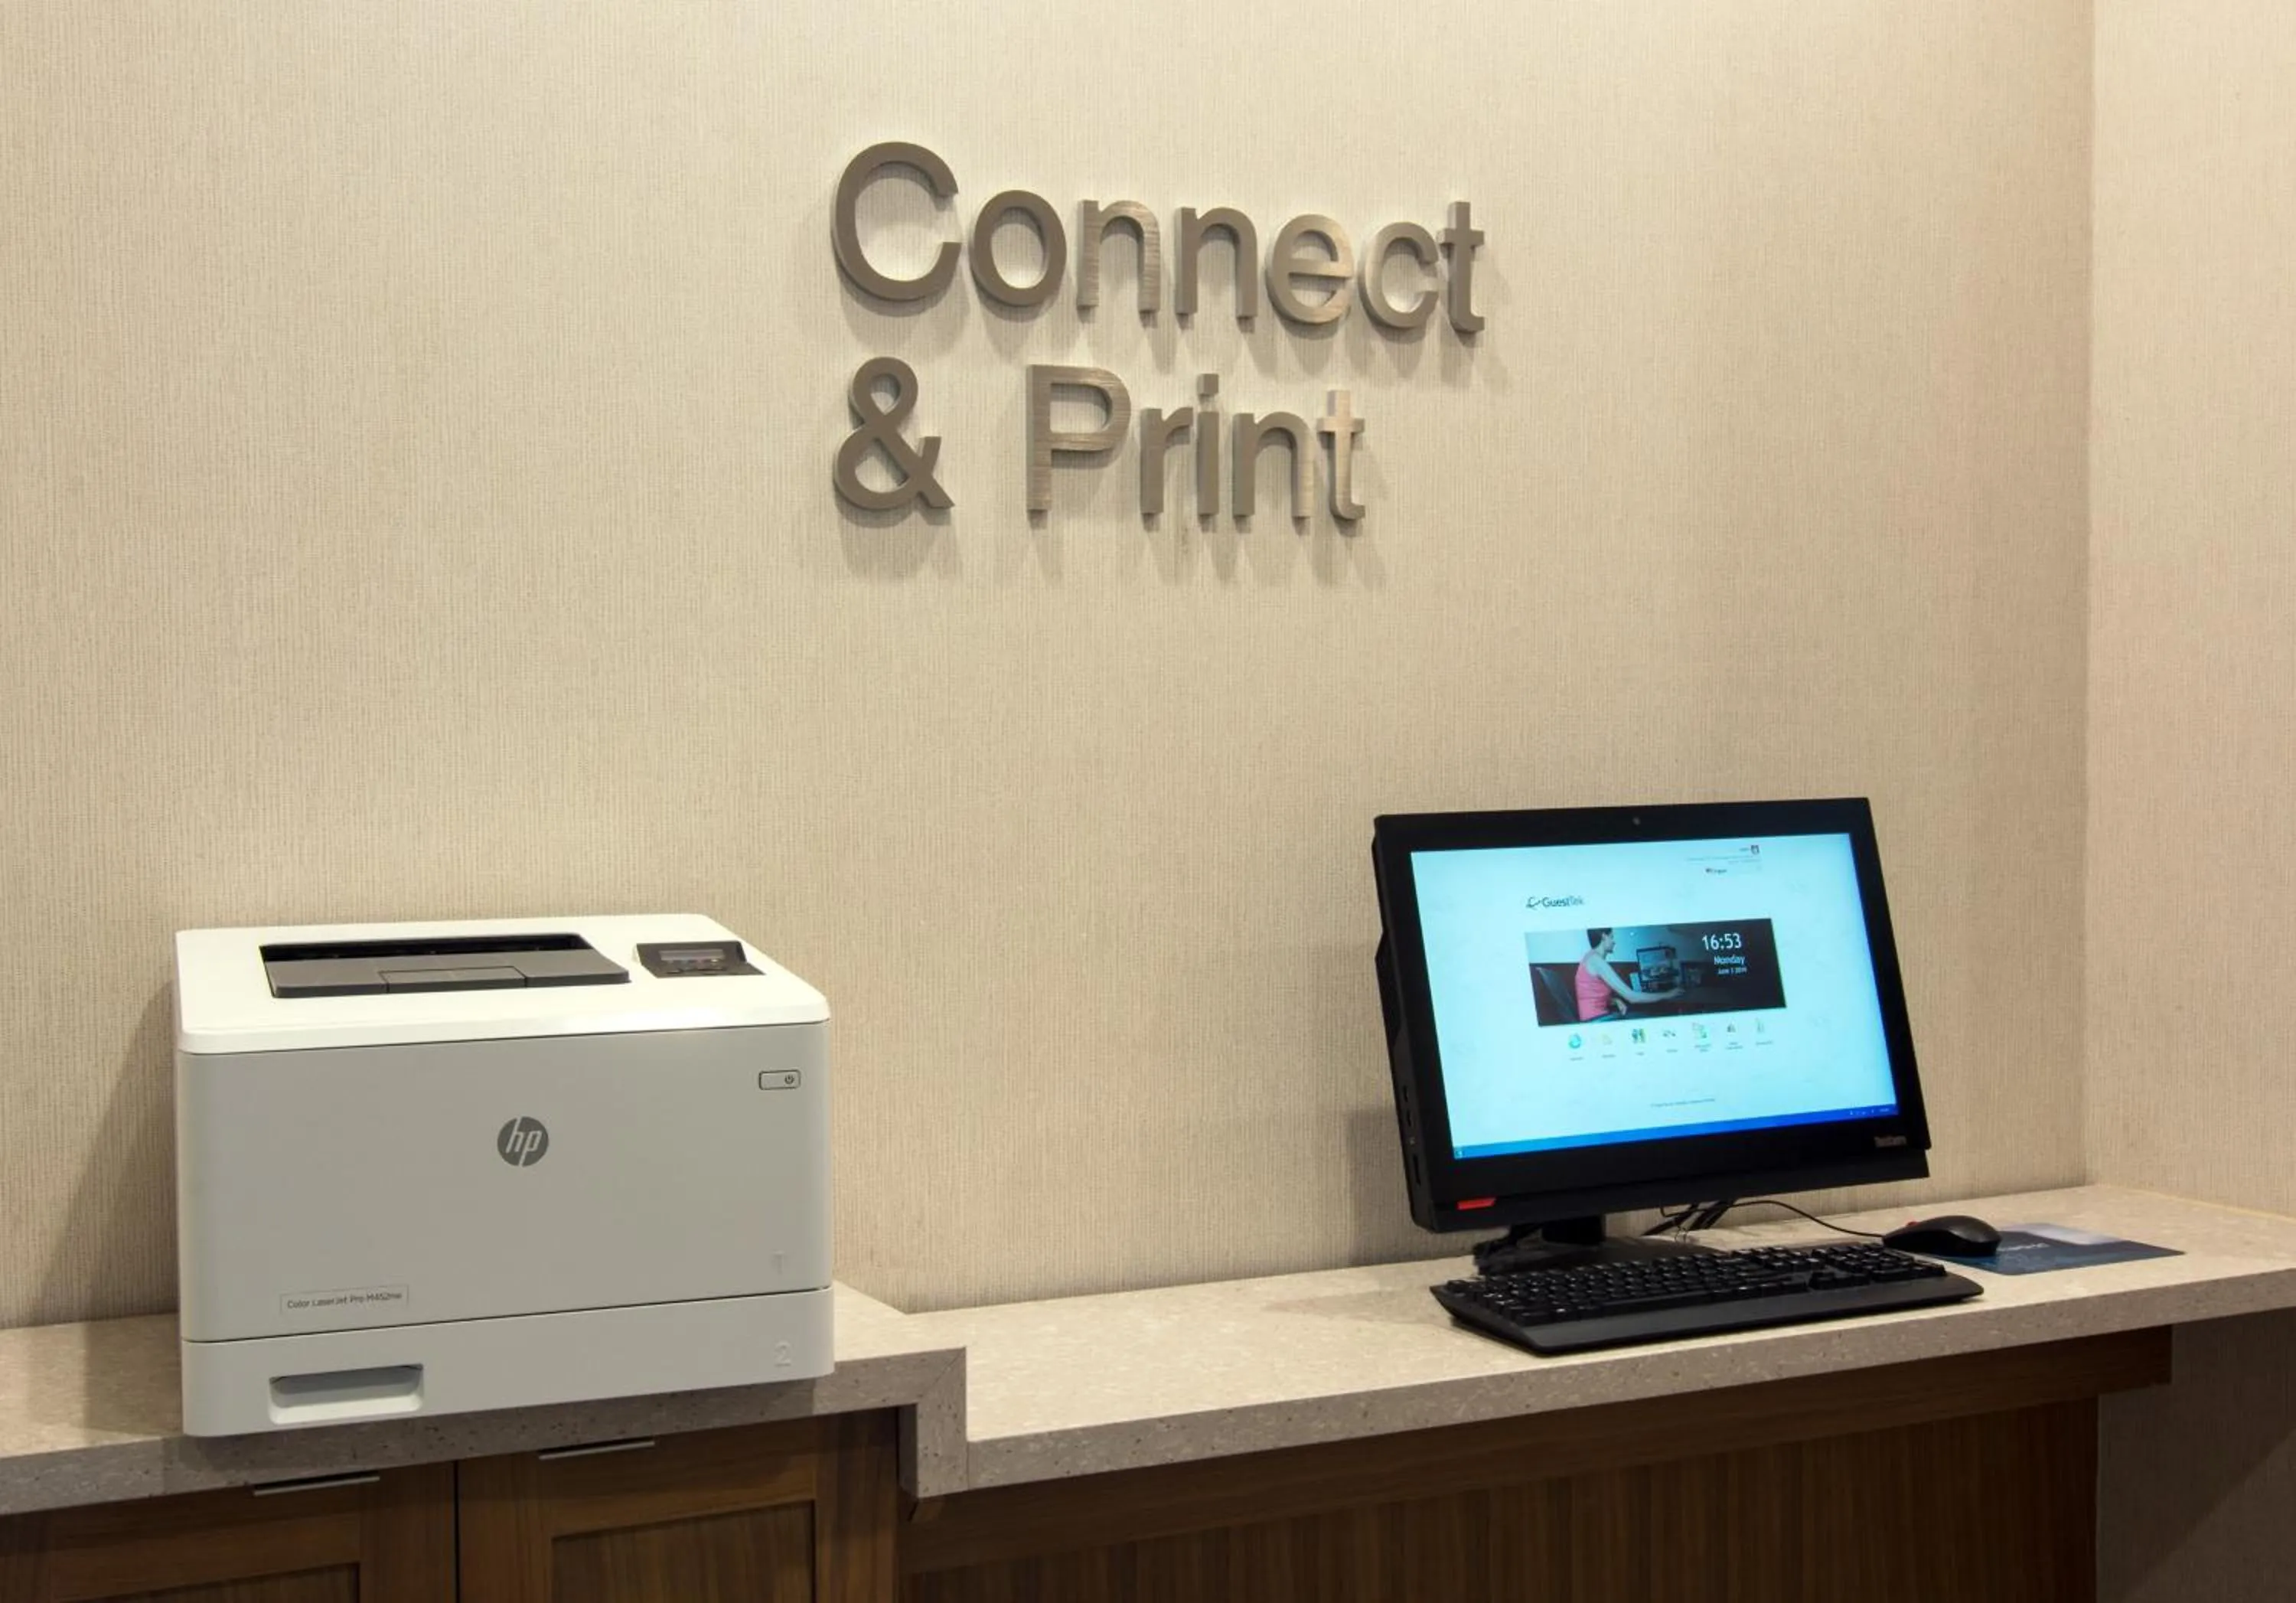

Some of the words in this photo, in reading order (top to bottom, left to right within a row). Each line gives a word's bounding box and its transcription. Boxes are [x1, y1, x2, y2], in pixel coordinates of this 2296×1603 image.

[832, 141, 1485, 332] Connect
[833, 356, 954, 510] &
[1026, 364, 1366, 521] Print
[1701, 932, 1743, 951] 16:53
[504, 1116, 544, 1166] hp
[287, 1298, 309, 1309] Color
